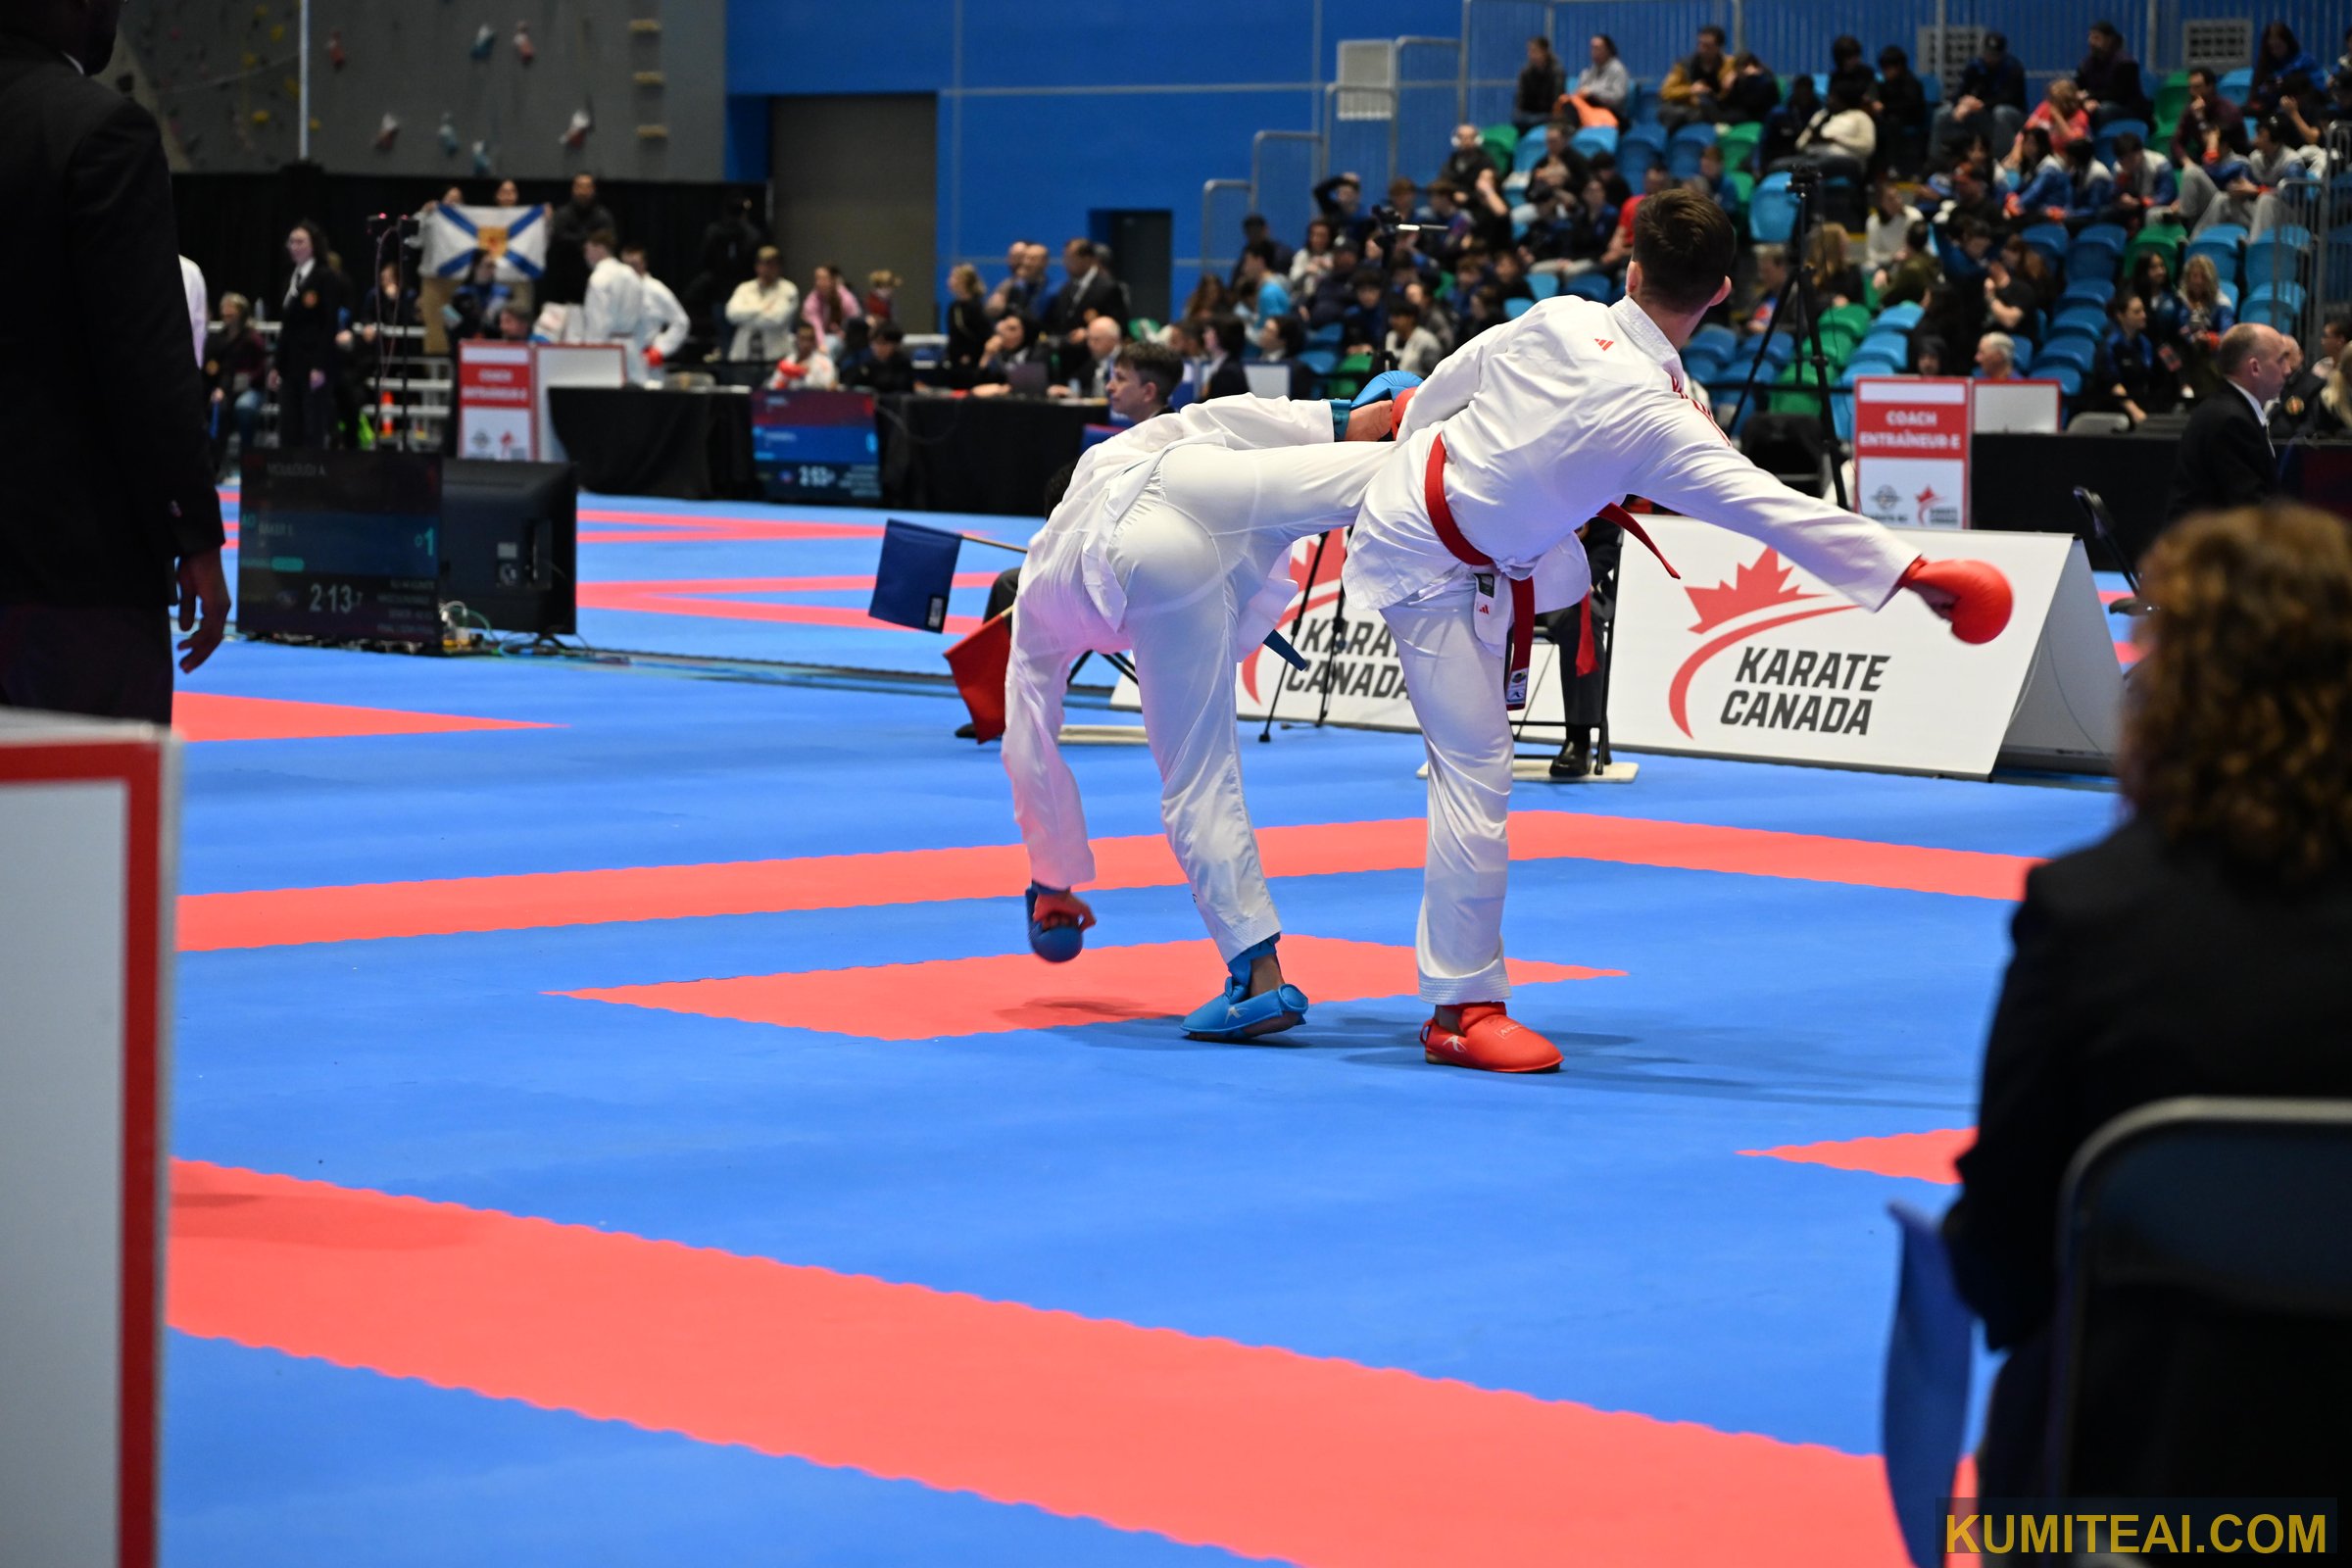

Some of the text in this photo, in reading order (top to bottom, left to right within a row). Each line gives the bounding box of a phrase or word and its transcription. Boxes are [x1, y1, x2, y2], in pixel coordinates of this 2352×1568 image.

[1886, 410, 1937, 426] COACH
[1735, 646, 1891, 692] KARATE
[1720, 689, 1873, 736] CANADA
